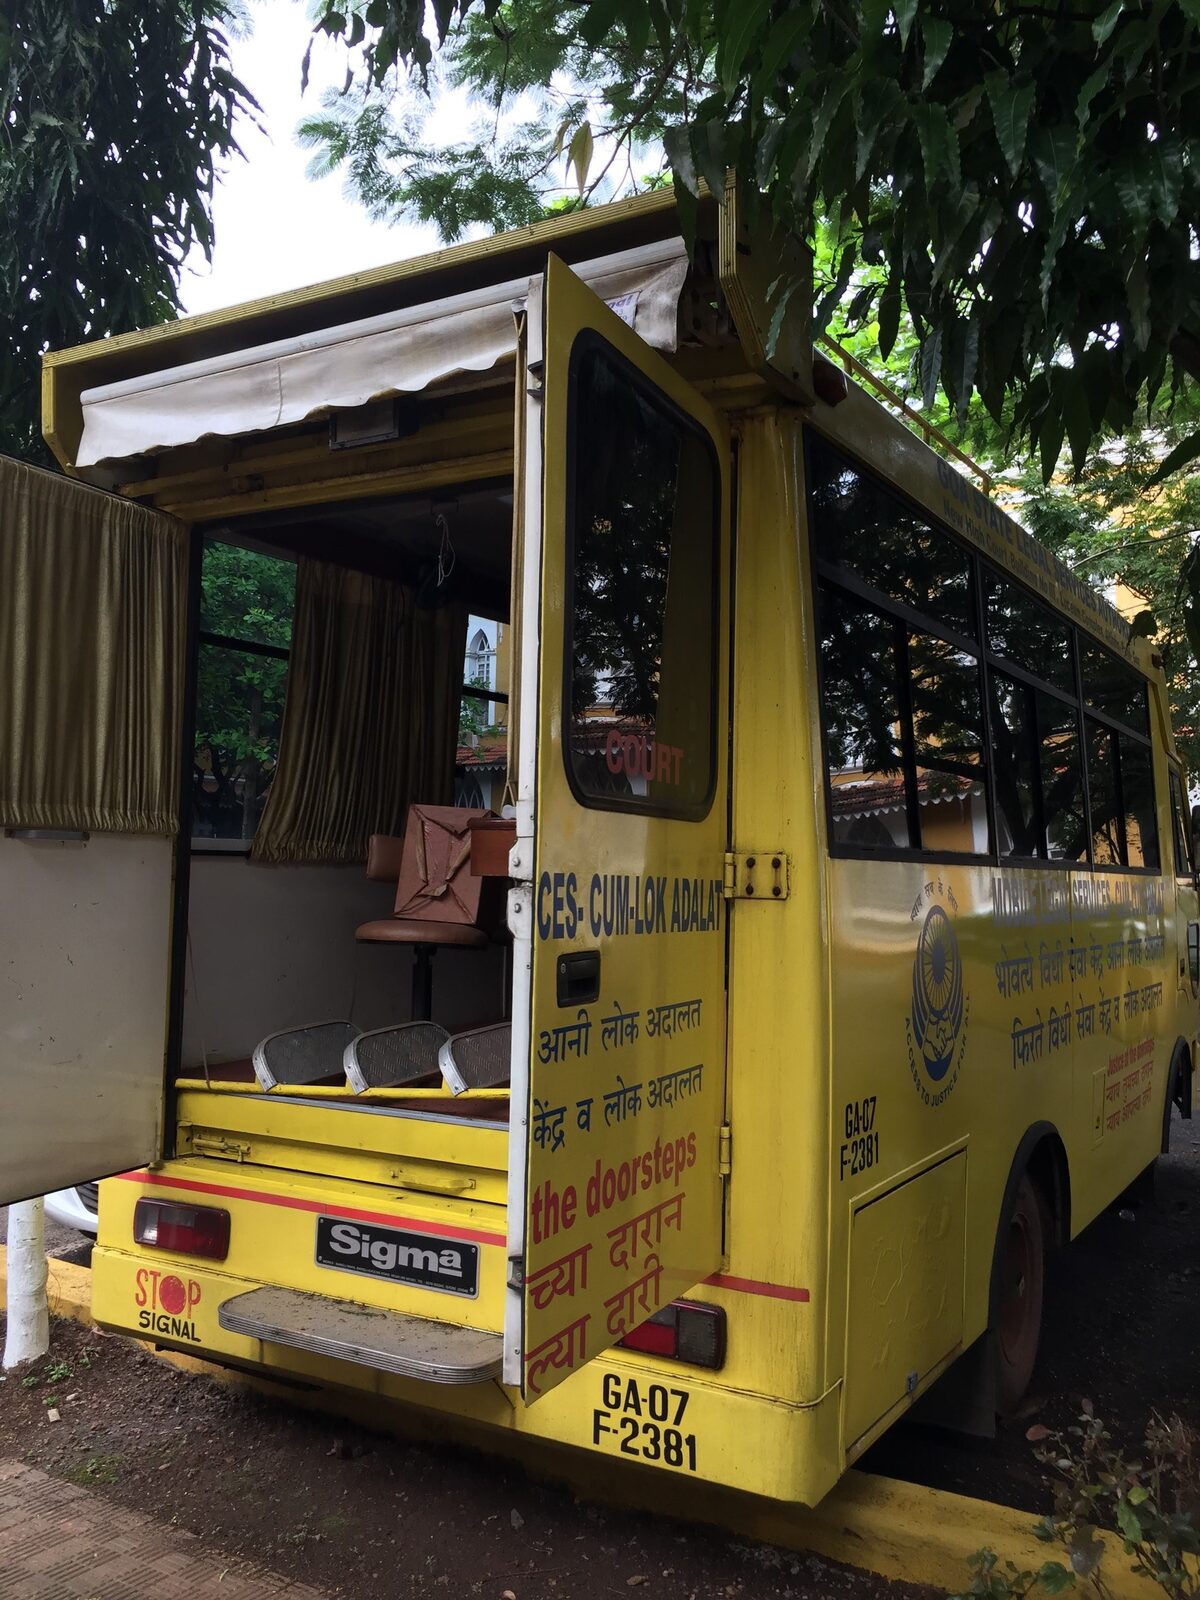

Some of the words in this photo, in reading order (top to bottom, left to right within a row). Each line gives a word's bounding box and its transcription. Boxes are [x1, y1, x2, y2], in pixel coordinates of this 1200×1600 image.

[973, 488, 1014, 546] STATE
[1016, 527, 1049, 577] LEGAL
[606, 730, 684, 785] COURT
[671, 877, 724, 933] ADALAT
[537, 1008, 592, 1064] आनी
[600, 1001, 640, 1051] लोक
[645, 998, 703, 1039] अदालत
[1011, 1007, 1044, 1070] फिरते
[1048, 1001, 1072, 1053] विधी
[1075, 992, 1095, 1041] सेवा
[1123, 981, 1139, 1021] लोक
[532, 1098, 567, 1152] केंद्र
[576, 1098, 593, 1132] व
[603, 1075, 643, 1127] लोक
[647, 1064, 704, 1109] अदालत
[845, 1096, 878, 1140] GA-07
[931, 1070, 958, 1106] JUSTICE
[840, 1131, 879, 1181] F-2381
[531, 1180, 577, 1245] the
[586, 1131, 697, 1219] doorsteps
[329, 1223, 463, 1278] Sigma
[606, 1192, 686, 1271] दारान
[603, 1253, 664, 1337] दारी
[138, 1309, 202, 1343] SIGNAL
[603, 1373, 690, 1427] GA-07
[592, 1408, 697, 1472] F-2381
